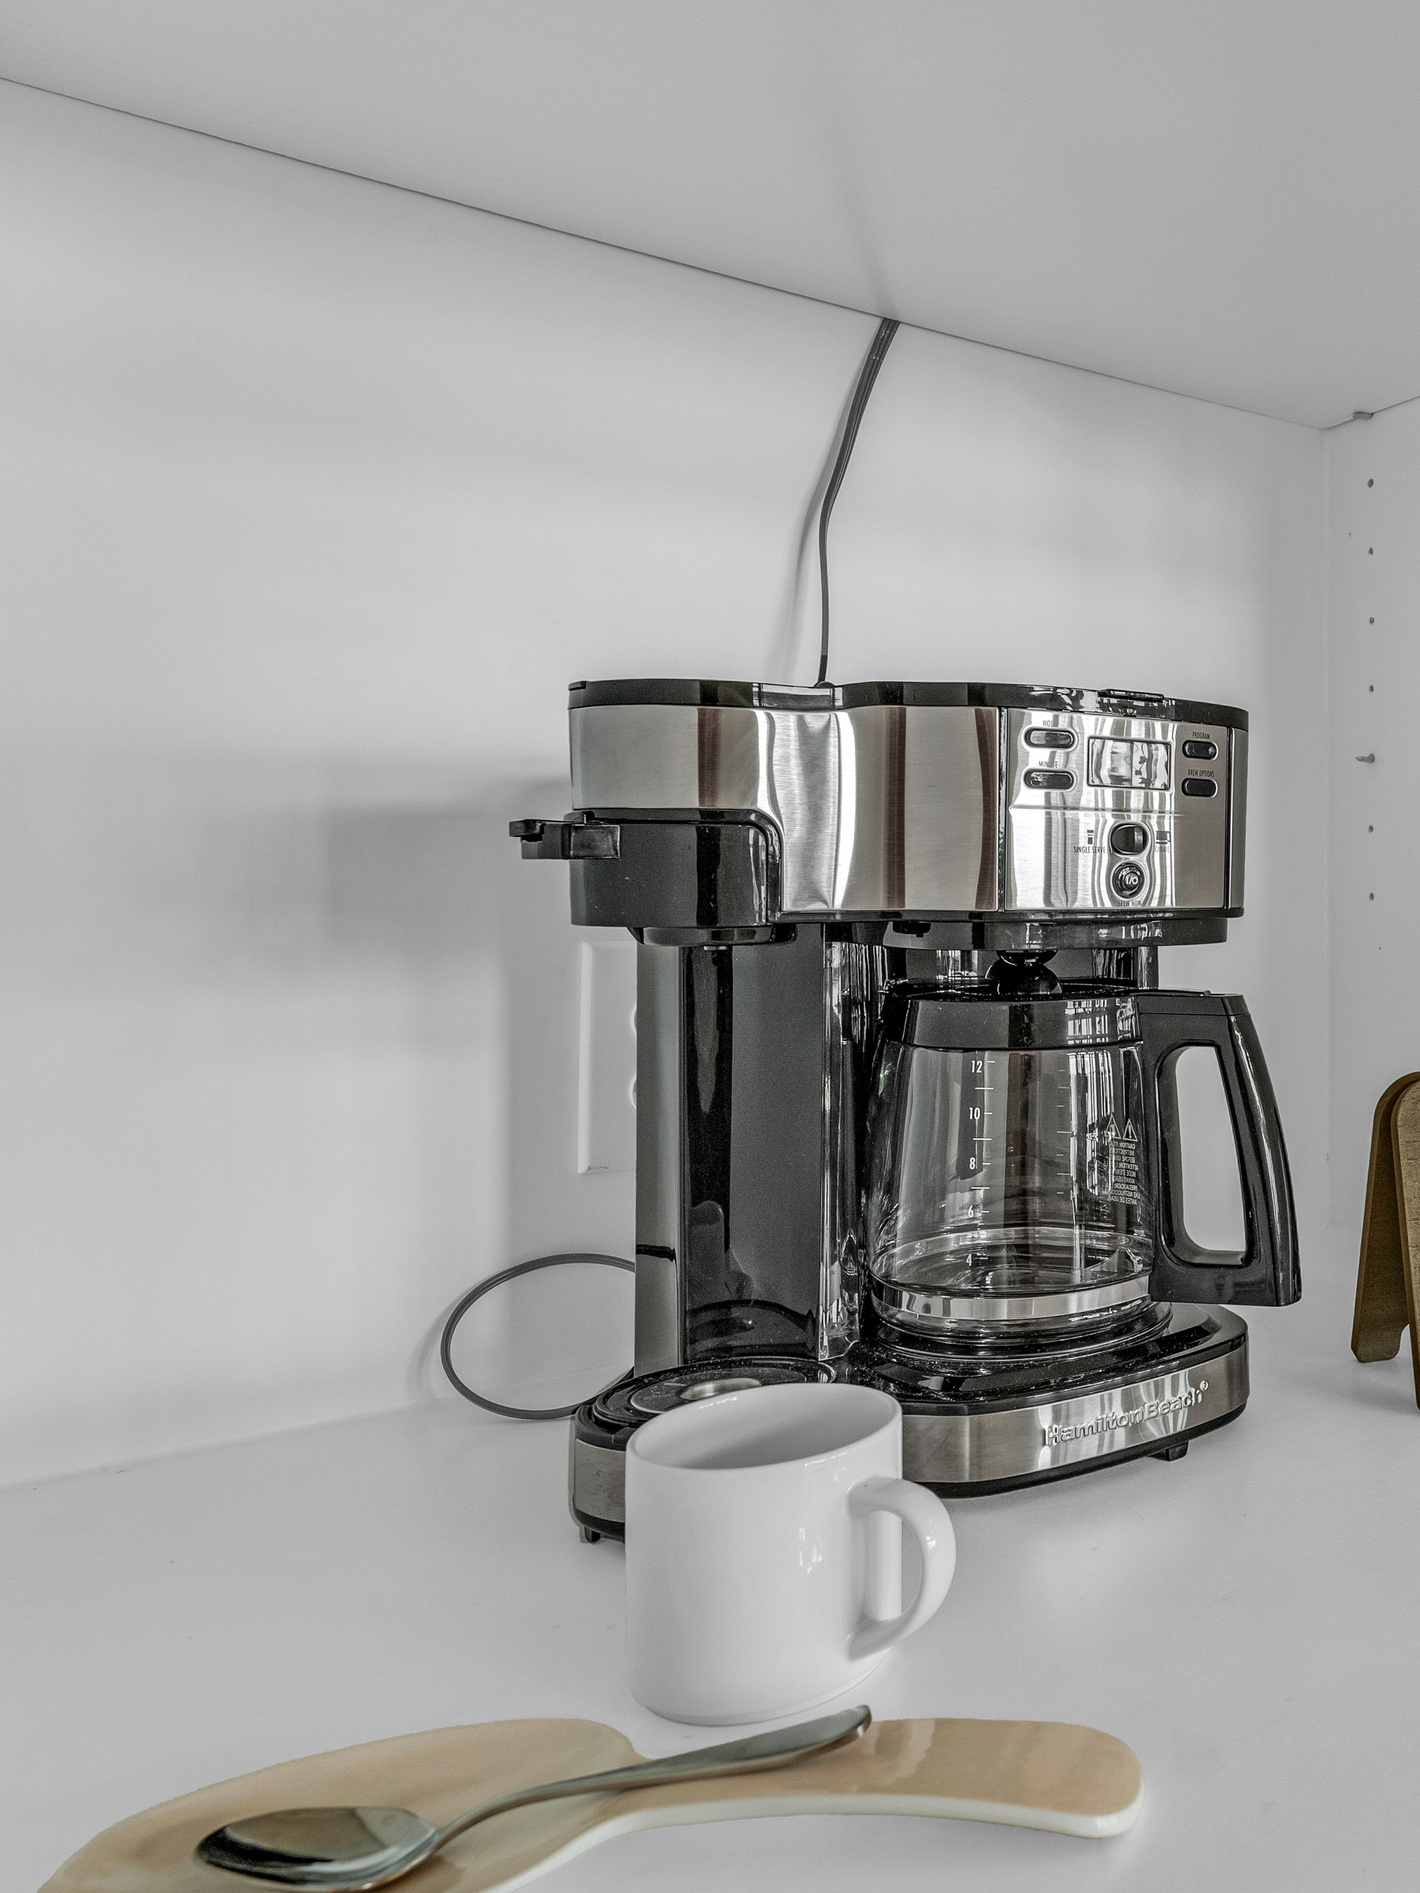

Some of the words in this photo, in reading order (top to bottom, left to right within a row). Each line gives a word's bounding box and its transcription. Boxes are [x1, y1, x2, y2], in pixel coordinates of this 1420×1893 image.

[1192, 731, 1210, 739] PROGRAM
[1199, 769, 1215, 777] OPTIONS
[1073, 845, 1090, 853] SINGLE
[971, 1061, 983, 1073] 12
[968, 1107, 981, 1120] 10
[969, 1157, 976, 1170] 8
[968, 1205, 974, 1218] 6
[966, 1254, 972, 1266] 4
